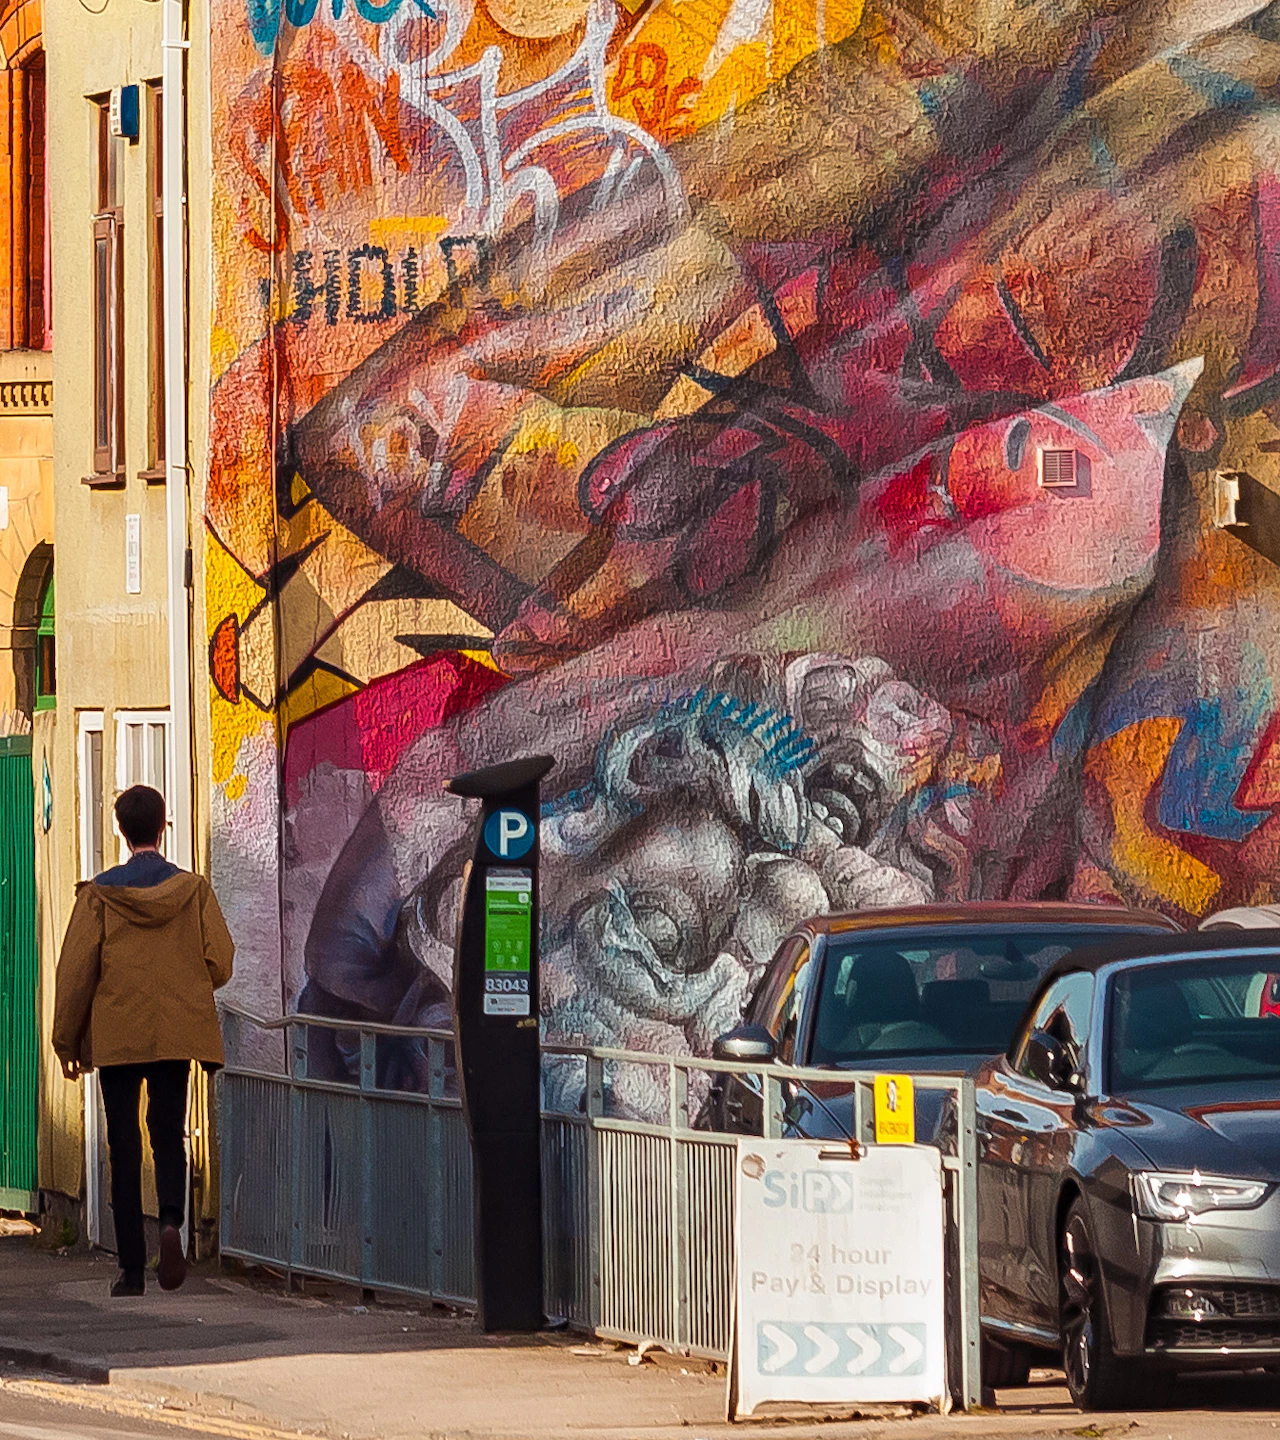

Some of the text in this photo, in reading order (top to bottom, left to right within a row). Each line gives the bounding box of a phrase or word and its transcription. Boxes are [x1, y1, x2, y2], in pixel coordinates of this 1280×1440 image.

[500, 812, 527, 856] P
[485, 978, 529, 992] 83043
[791, 1243, 891, 1265] 24 hour
[751, 1271, 932, 1300] Pay & Display
